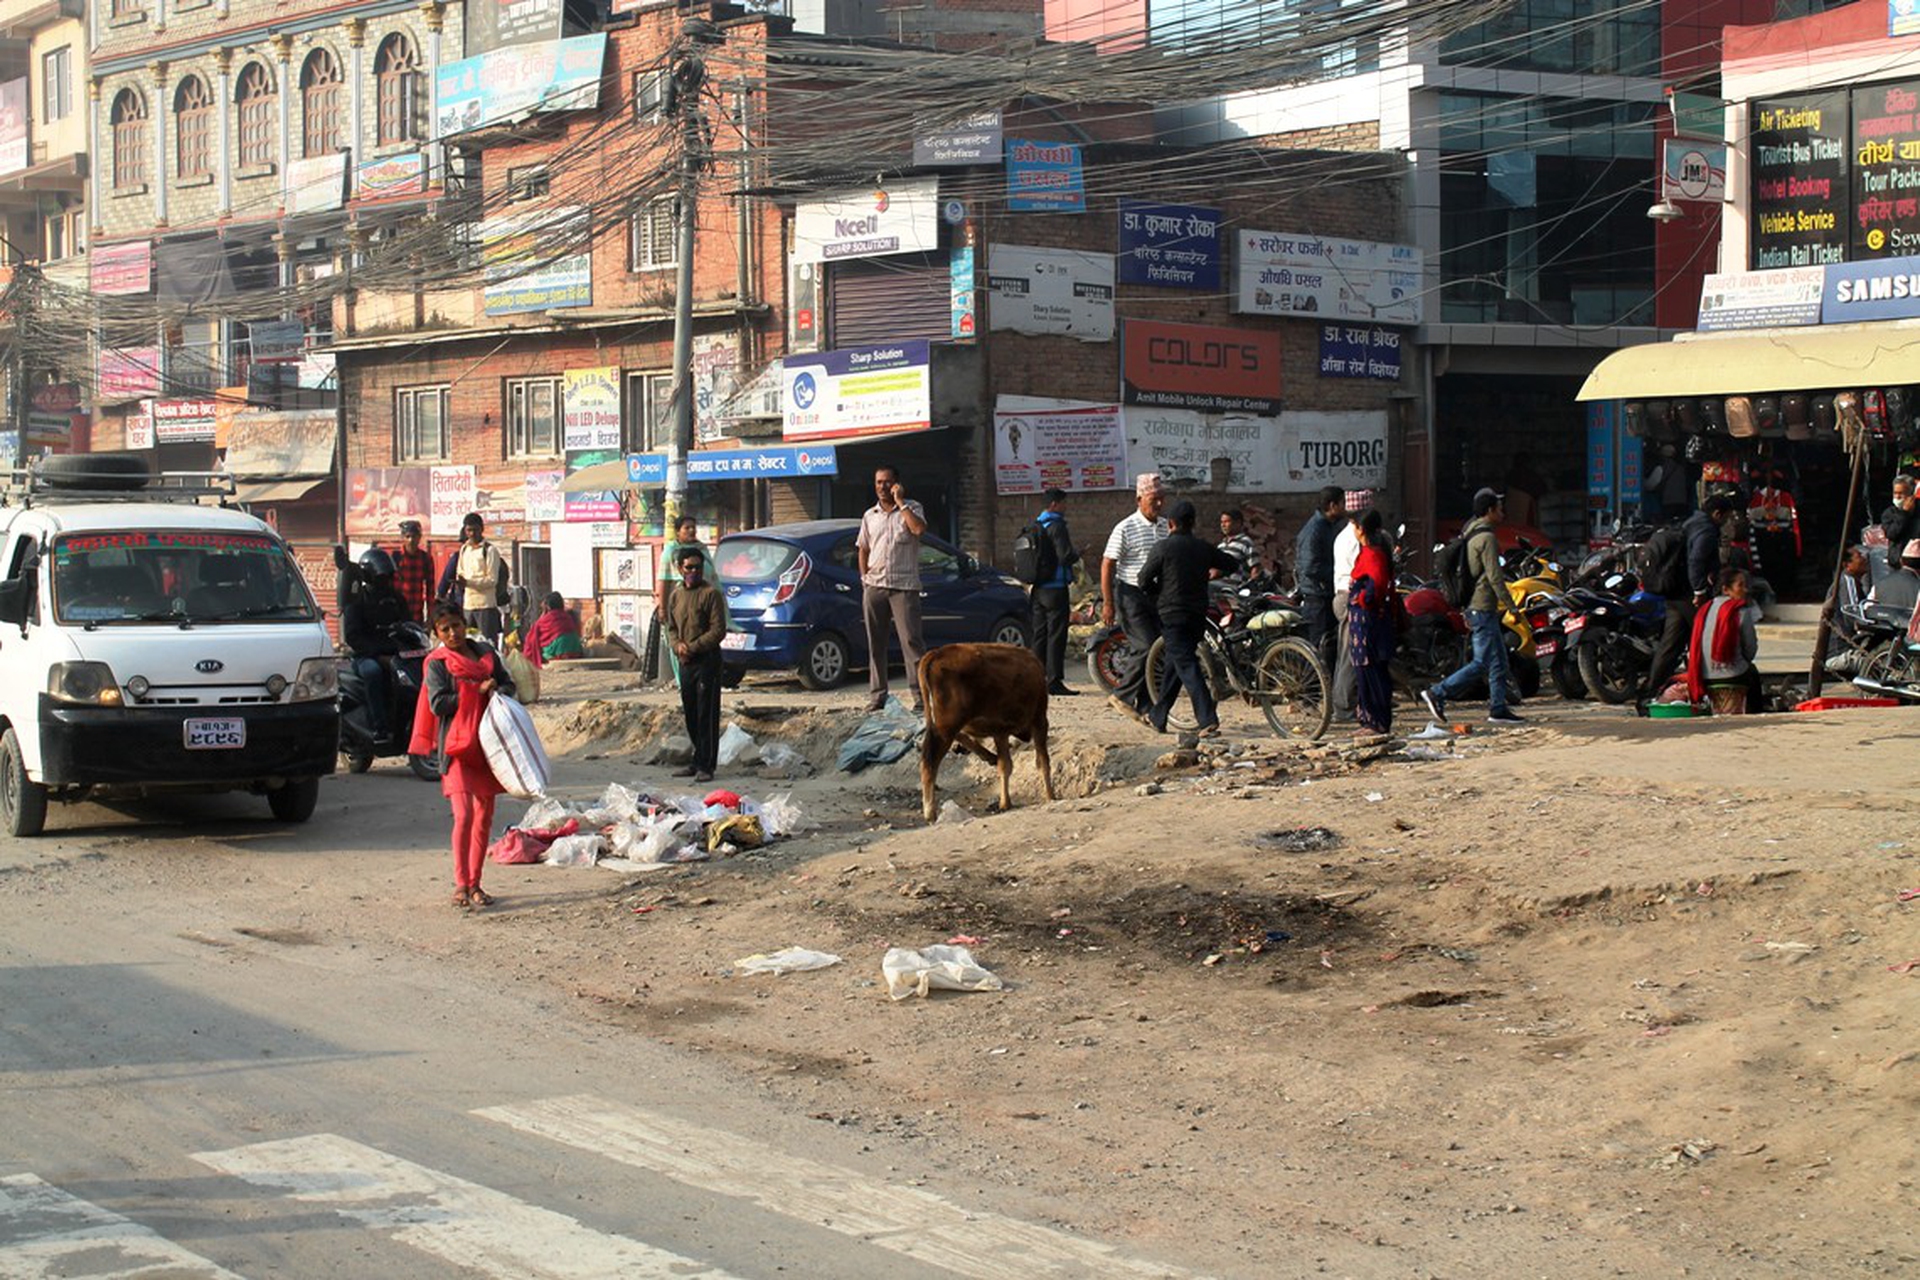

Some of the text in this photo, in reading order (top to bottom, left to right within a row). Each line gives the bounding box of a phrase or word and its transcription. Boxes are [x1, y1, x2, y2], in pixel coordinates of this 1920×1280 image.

[1760, 107, 1821, 132] Air Ticketing
[1758, 137, 1843, 165] Tourist Bus Ticket
[1858, 138, 1894, 166] तीर्थ
[1759, 176, 1831, 199] Hotel Booking
[1863, 171, 1888, 192] Tour
[834, 214, 878, 238] Ncell
[1124, 213, 1216, 238] डा. कुमार रोका
[1759, 209, 1835, 234] Vehicle Service
[825, 243, 851, 257] SHARP
[852, 238, 891, 252] SOLUTION
[1759, 243, 1843, 268] Indian Rail Ticket
[1295, 274, 1322, 288] पसल
[1324, 326, 1400, 348] डा. राम श्रेष्ठ
[850, 348, 904, 364] Sharp Solution
[1136, 392, 1270, 411] Amit Mobile Unlock Repair Center
[1143, 417, 1194, 437] रामेछाप
[757, 454, 786, 471] सेन्टर
[811, 455, 833, 468] pepsi
[1300, 438, 1384, 469] TUBORG
[432, 470, 471, 492] सितादेवी
[432, 497, 453, 515] कोल्ड
[200, 661, 219, 671] KIA
